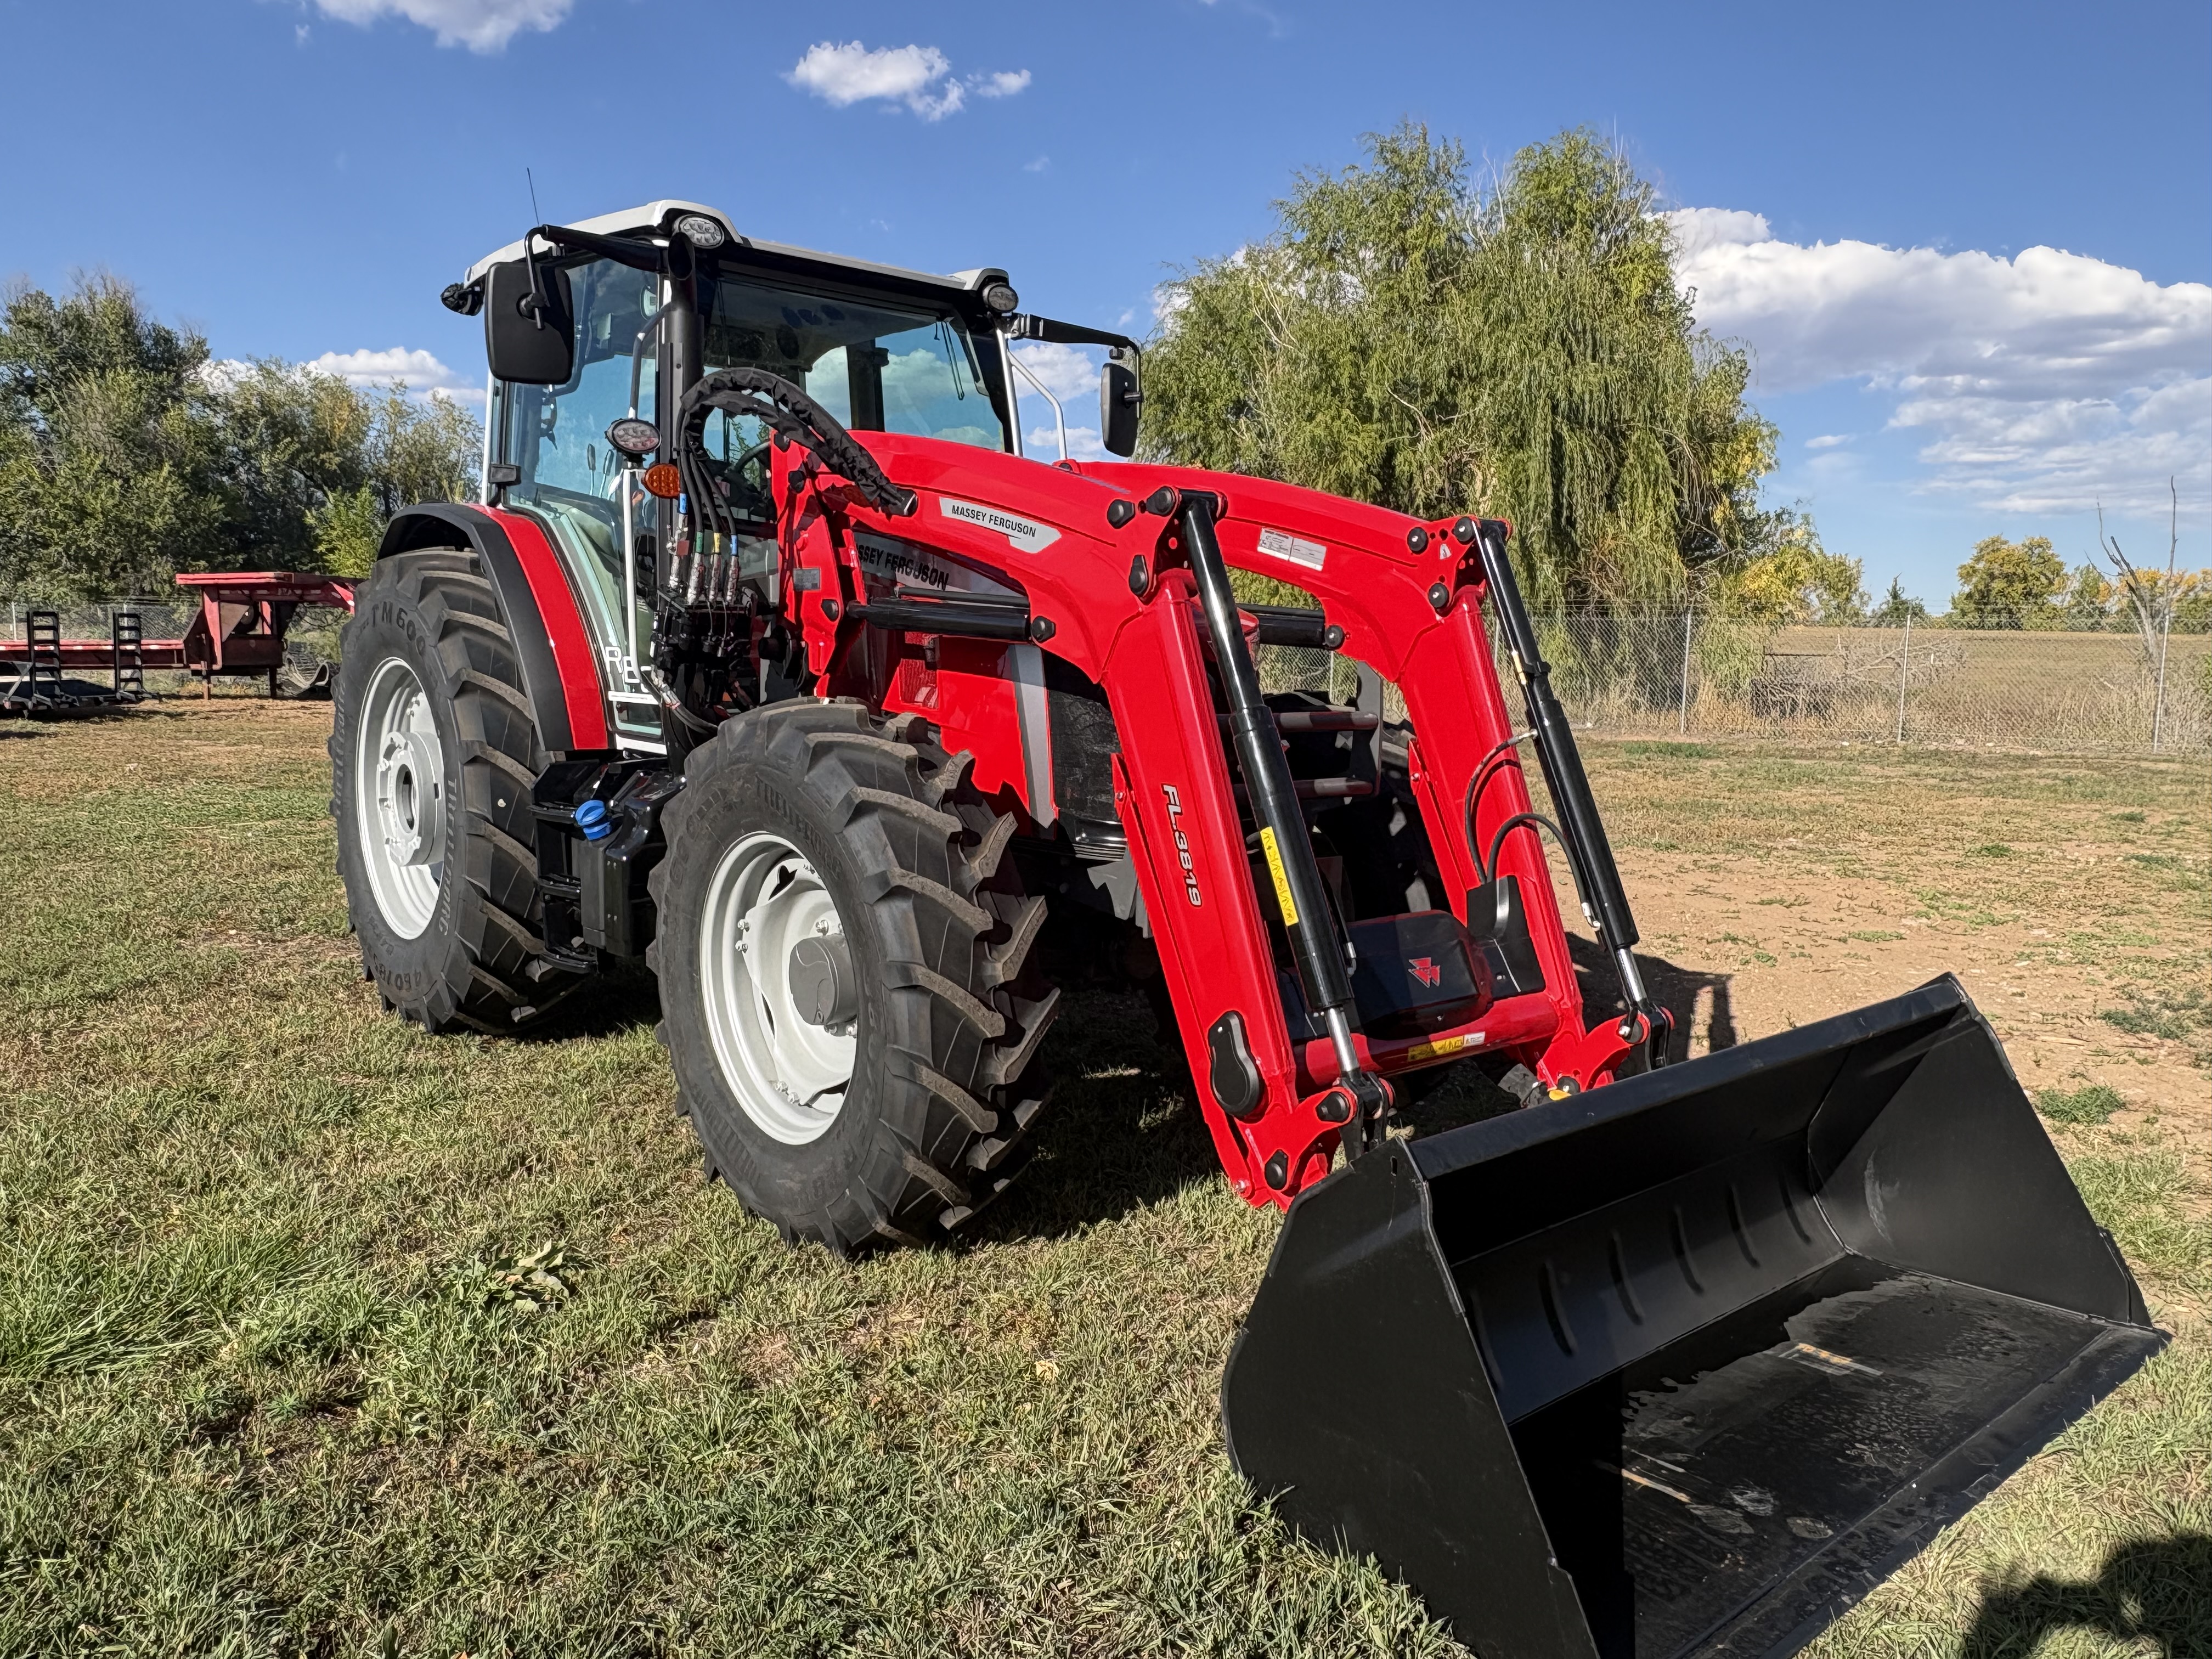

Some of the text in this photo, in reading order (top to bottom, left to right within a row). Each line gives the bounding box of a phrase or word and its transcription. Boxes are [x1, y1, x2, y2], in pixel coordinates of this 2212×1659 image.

[952, 505, 1036, 538] MASSEY FERGUSON
[856, 544, 950, 591] SSEY FERGUSON
